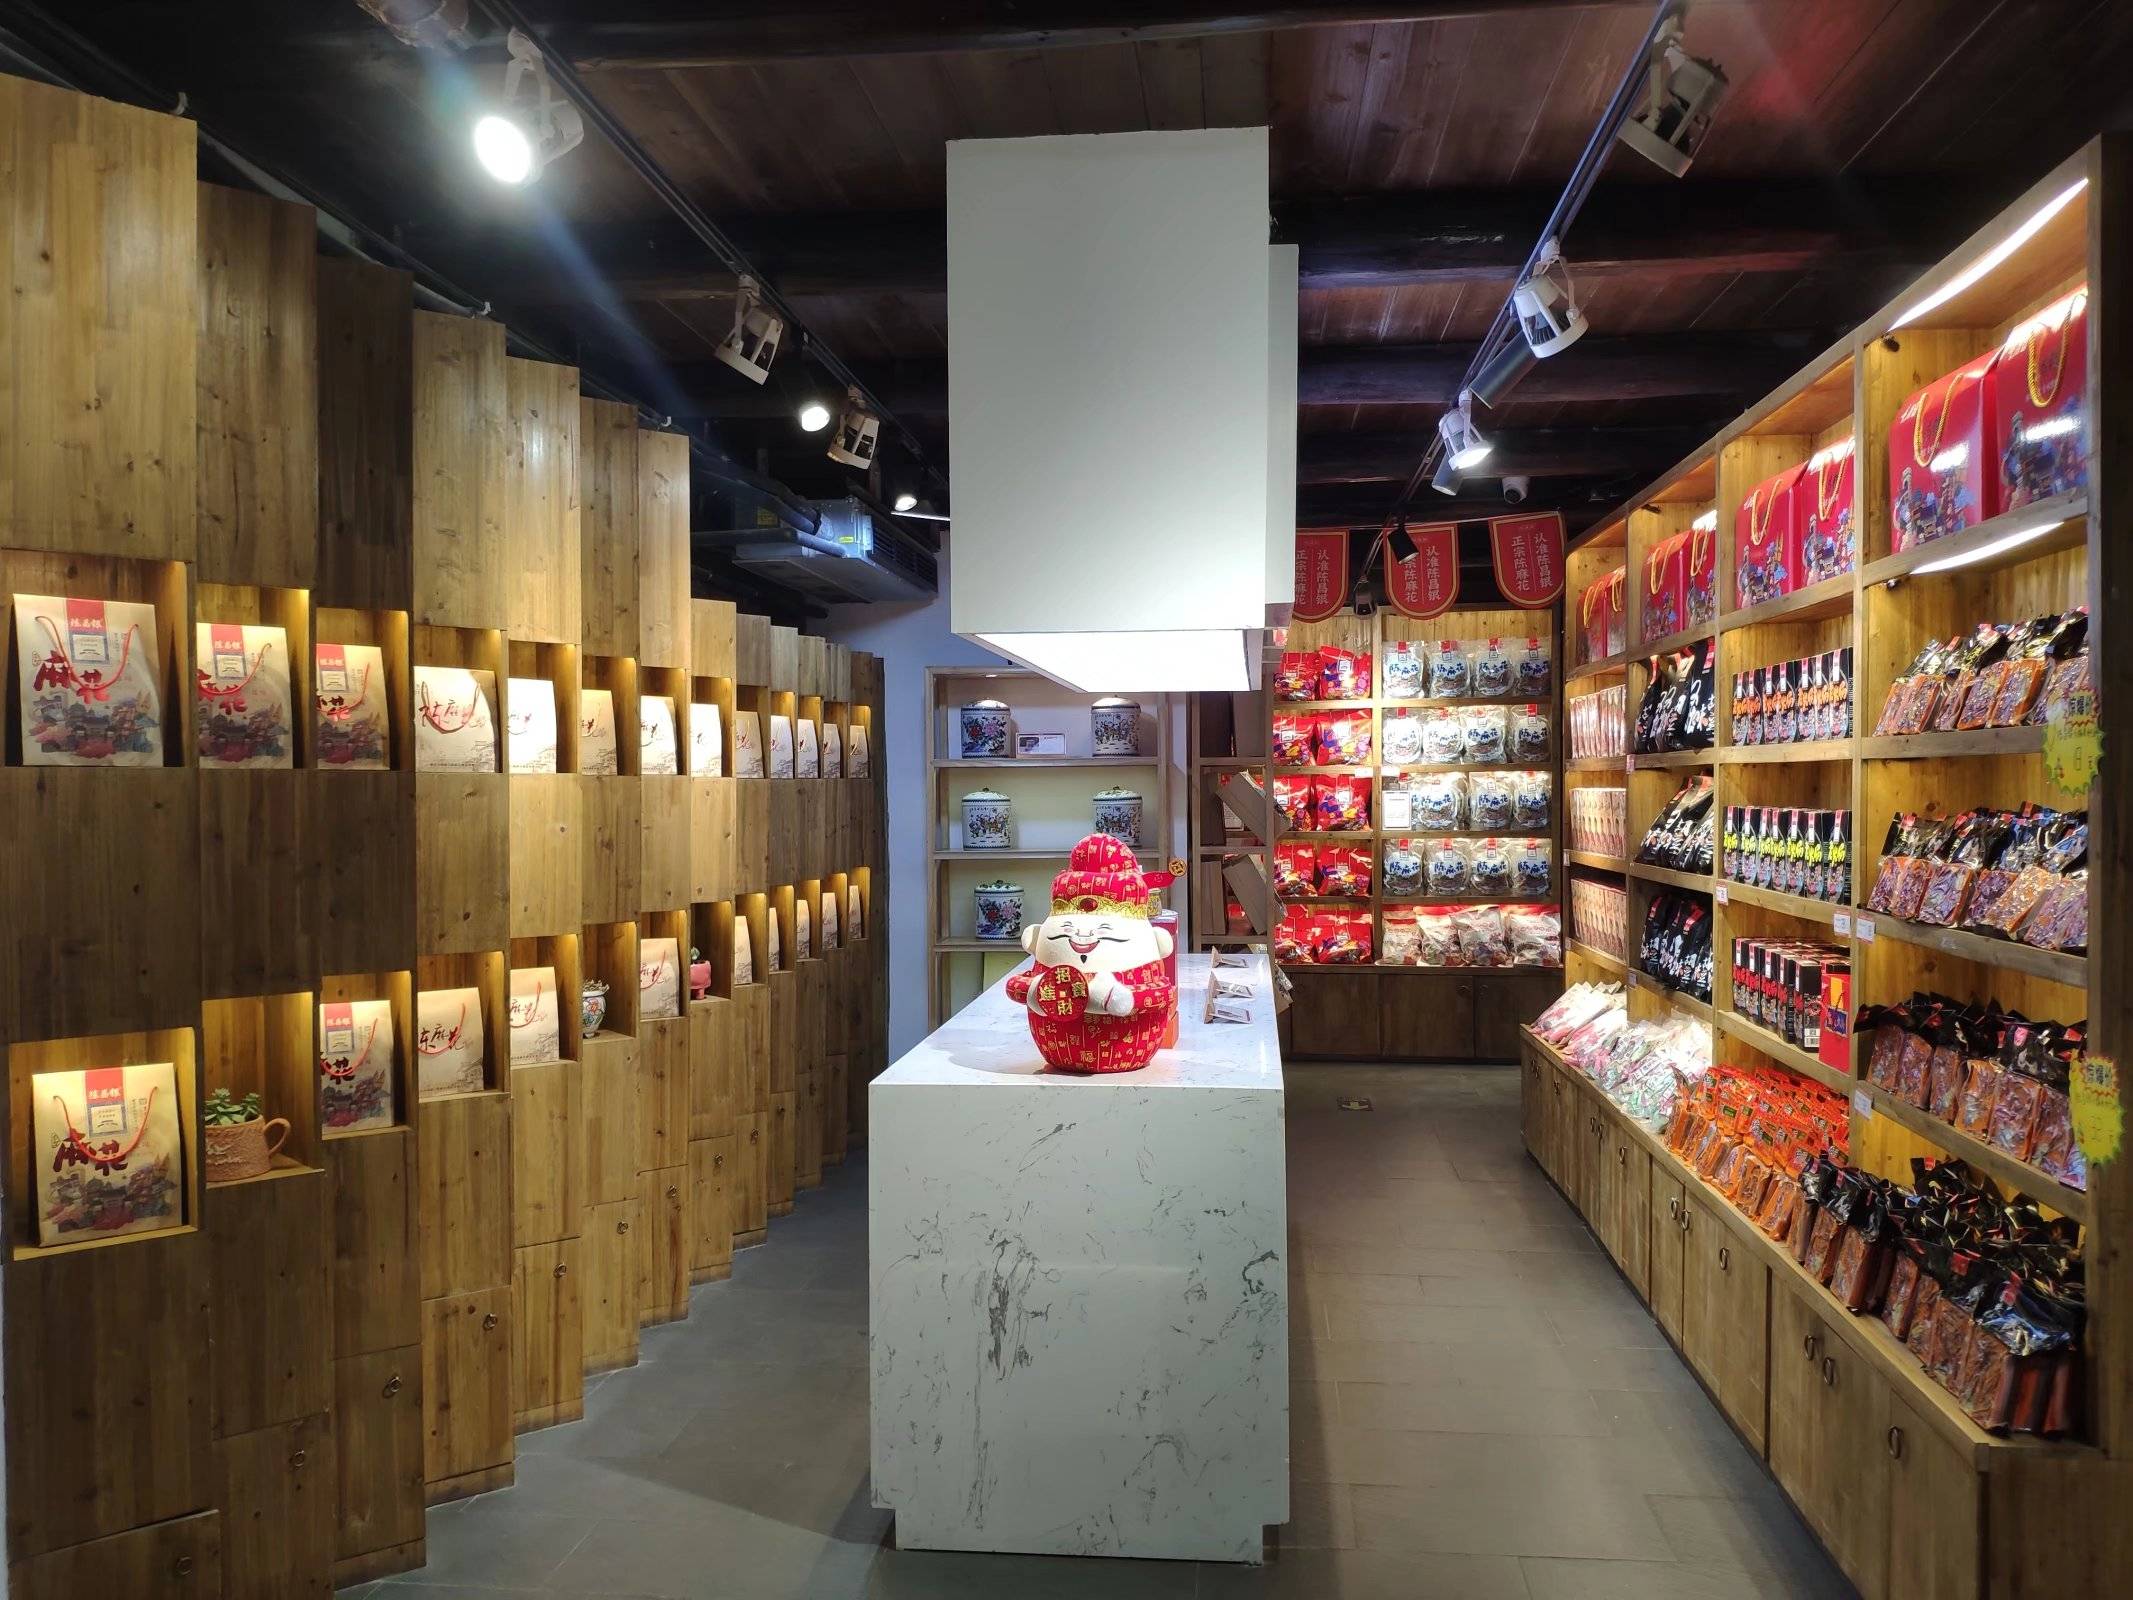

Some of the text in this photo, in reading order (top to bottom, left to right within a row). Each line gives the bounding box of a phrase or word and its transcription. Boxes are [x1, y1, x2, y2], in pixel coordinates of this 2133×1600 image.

[1511, 535, 1530, 591] 正宗陈麻花
[1533, 532, 1553, 588] 认准陈昌银
[1316, 549, 1329, 604] 认准陈昌银
[1426, 545, 1440, 601] 认准陈昌银
[1403, 559, 1418, 603] 宗陈麻花
[1389, 663, 1419, 675] 陈麻花
[1437, 662, 1465, 676] 陈麻花
[33, 649, 112, 704] 麻花
[1468, 728, 1498, 740] 陈麻花
[1519, 727, 1548, 740] 陈麻花
[1479, 793, 1508, 807] 陈麻花
[1519, 792, 1548, 807] 陈麻花
[1389, 861, 1419, 875] 陈麻花
[1434, 861, 1464, 875] 陈麻花
[1477, 860, 1506, 874] 陈麻花
[1518, 860, 1549, 874] 陈麻花
[52, 1127, 129, 1177] 麻花
